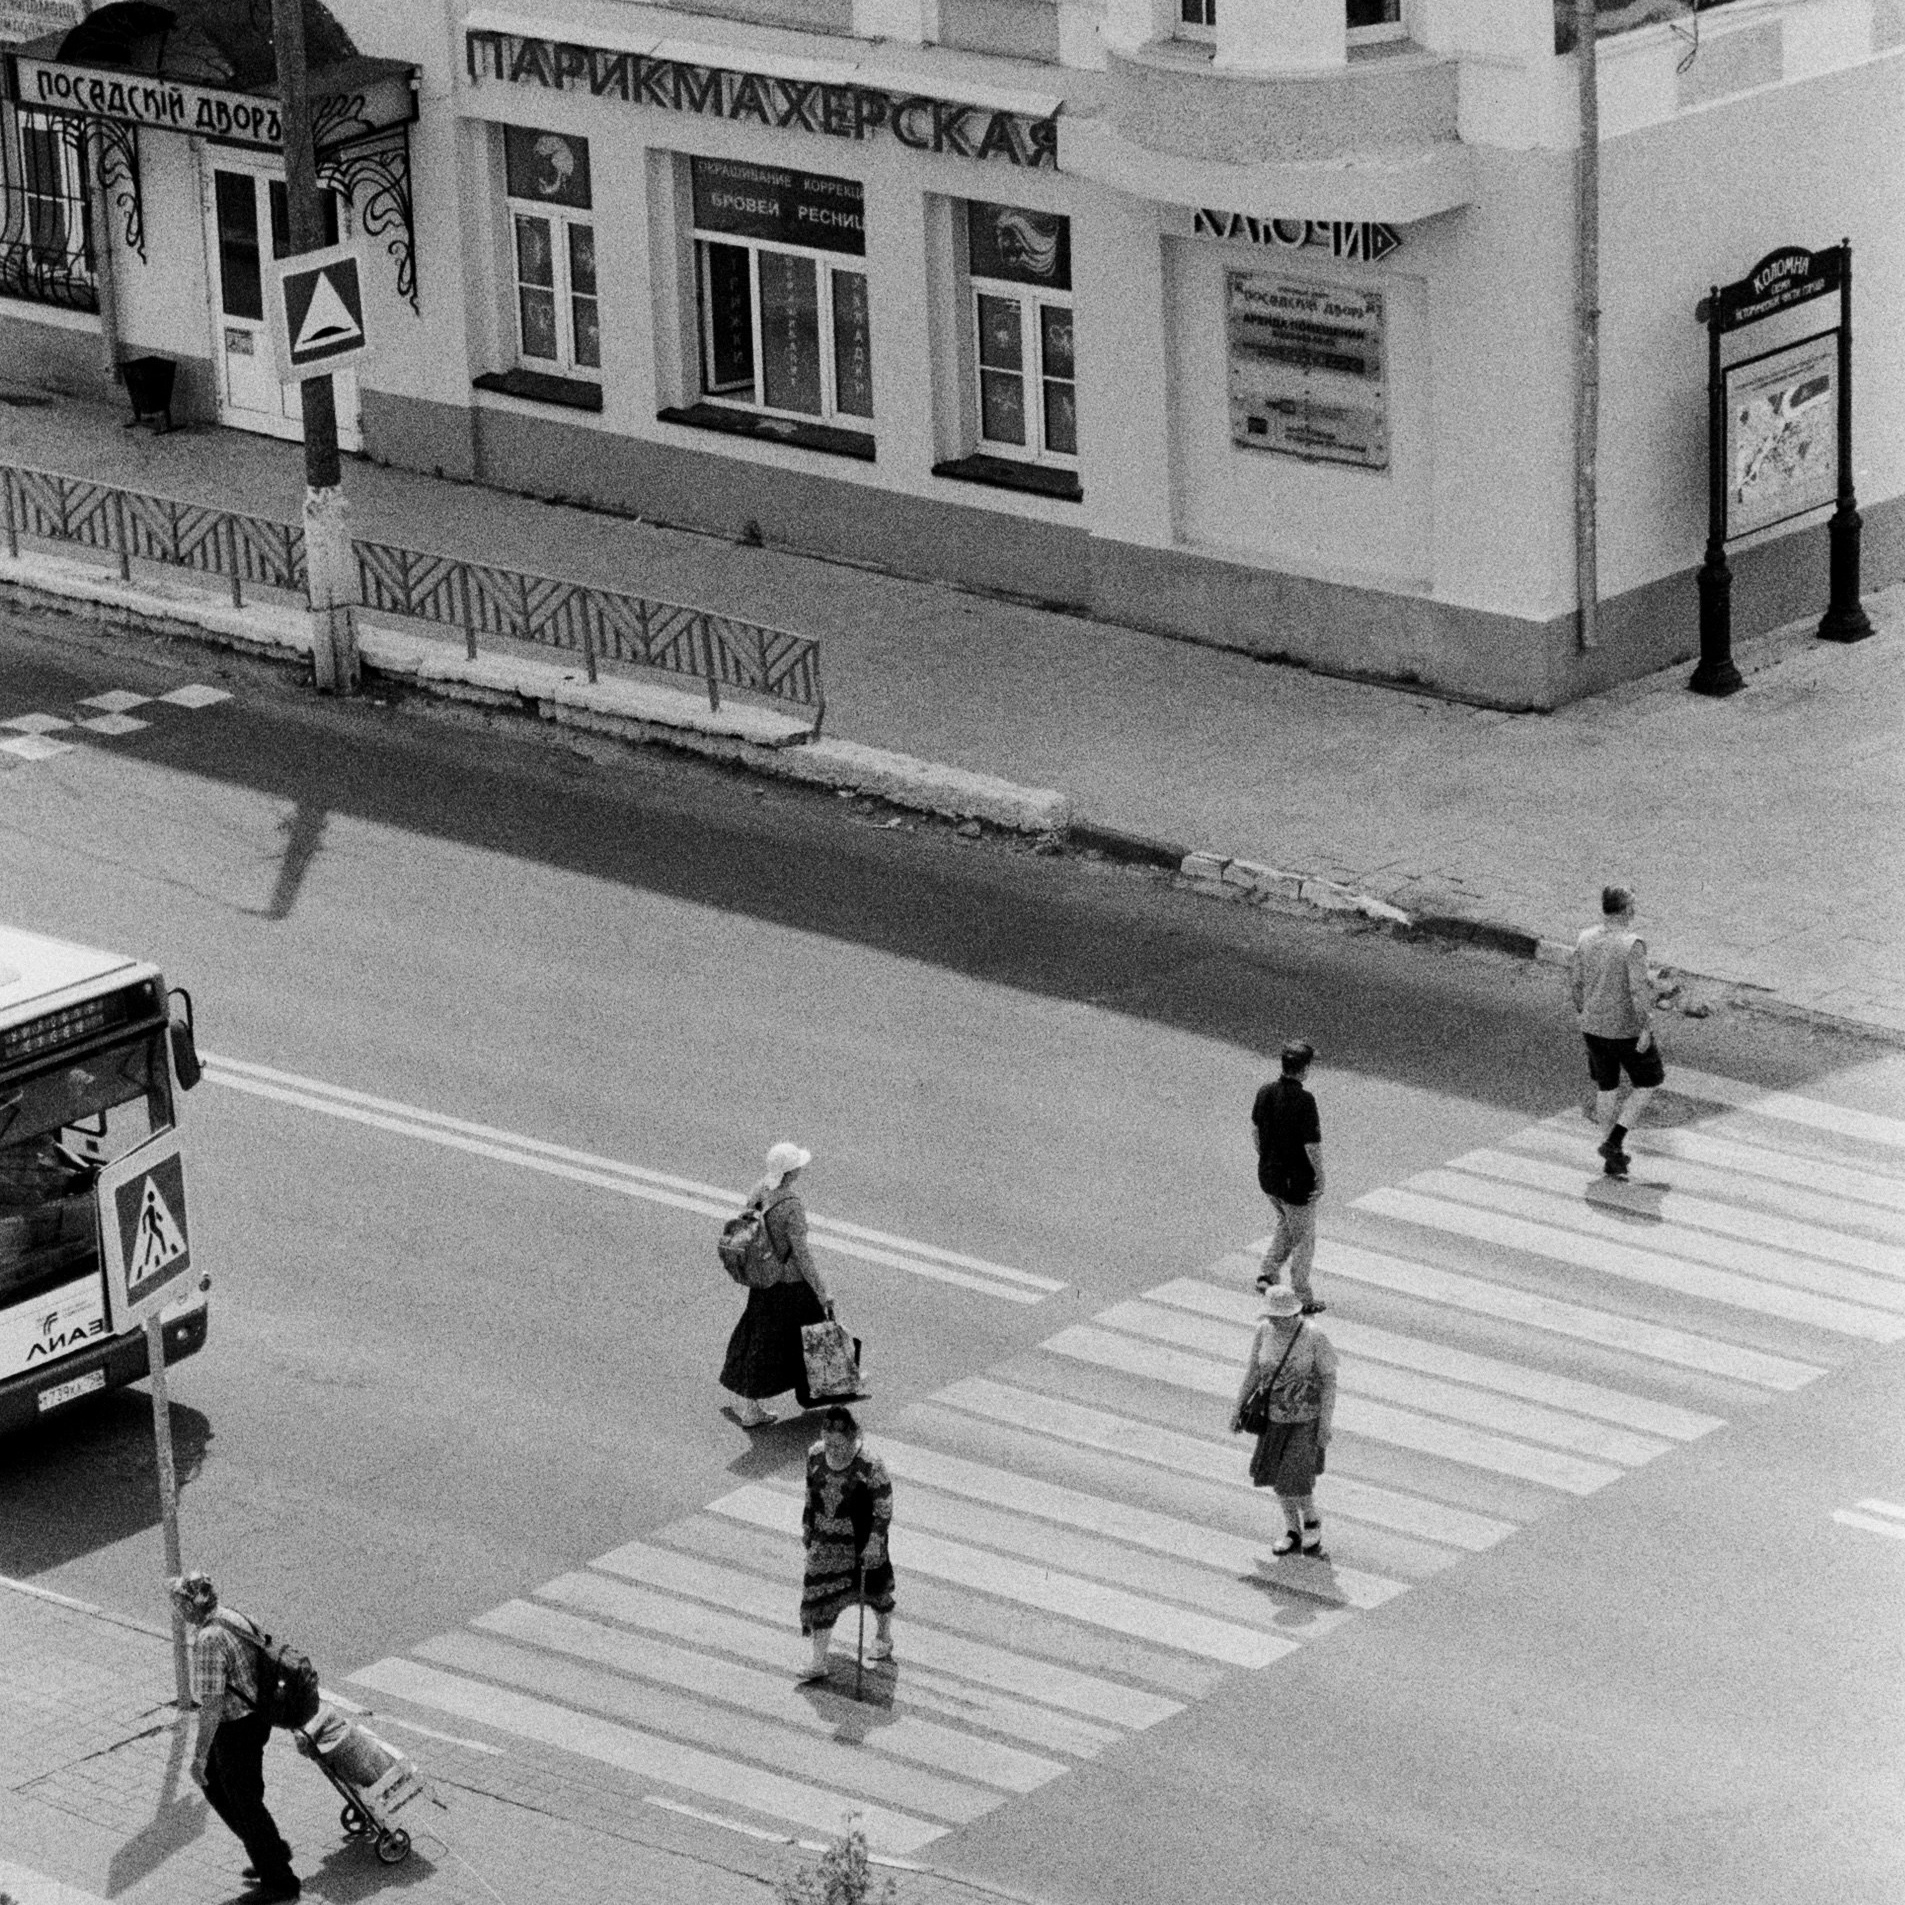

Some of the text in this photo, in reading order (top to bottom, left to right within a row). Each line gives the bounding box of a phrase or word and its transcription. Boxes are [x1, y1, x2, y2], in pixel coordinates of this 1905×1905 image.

[36, 69, 282, 142] ПОСАДСКІЙ ДВОРЪ
[464, 30, 1058, 168] ПАРИКМАХЕРСКАЯ
[698, 161, 864, 201] ОКРАШИВАНИЕ КОРРЕКЦ
[711, 192, 780, 218] БРОВЕЙ
[1754, 256, 1810, 295] КОЛОМНА
